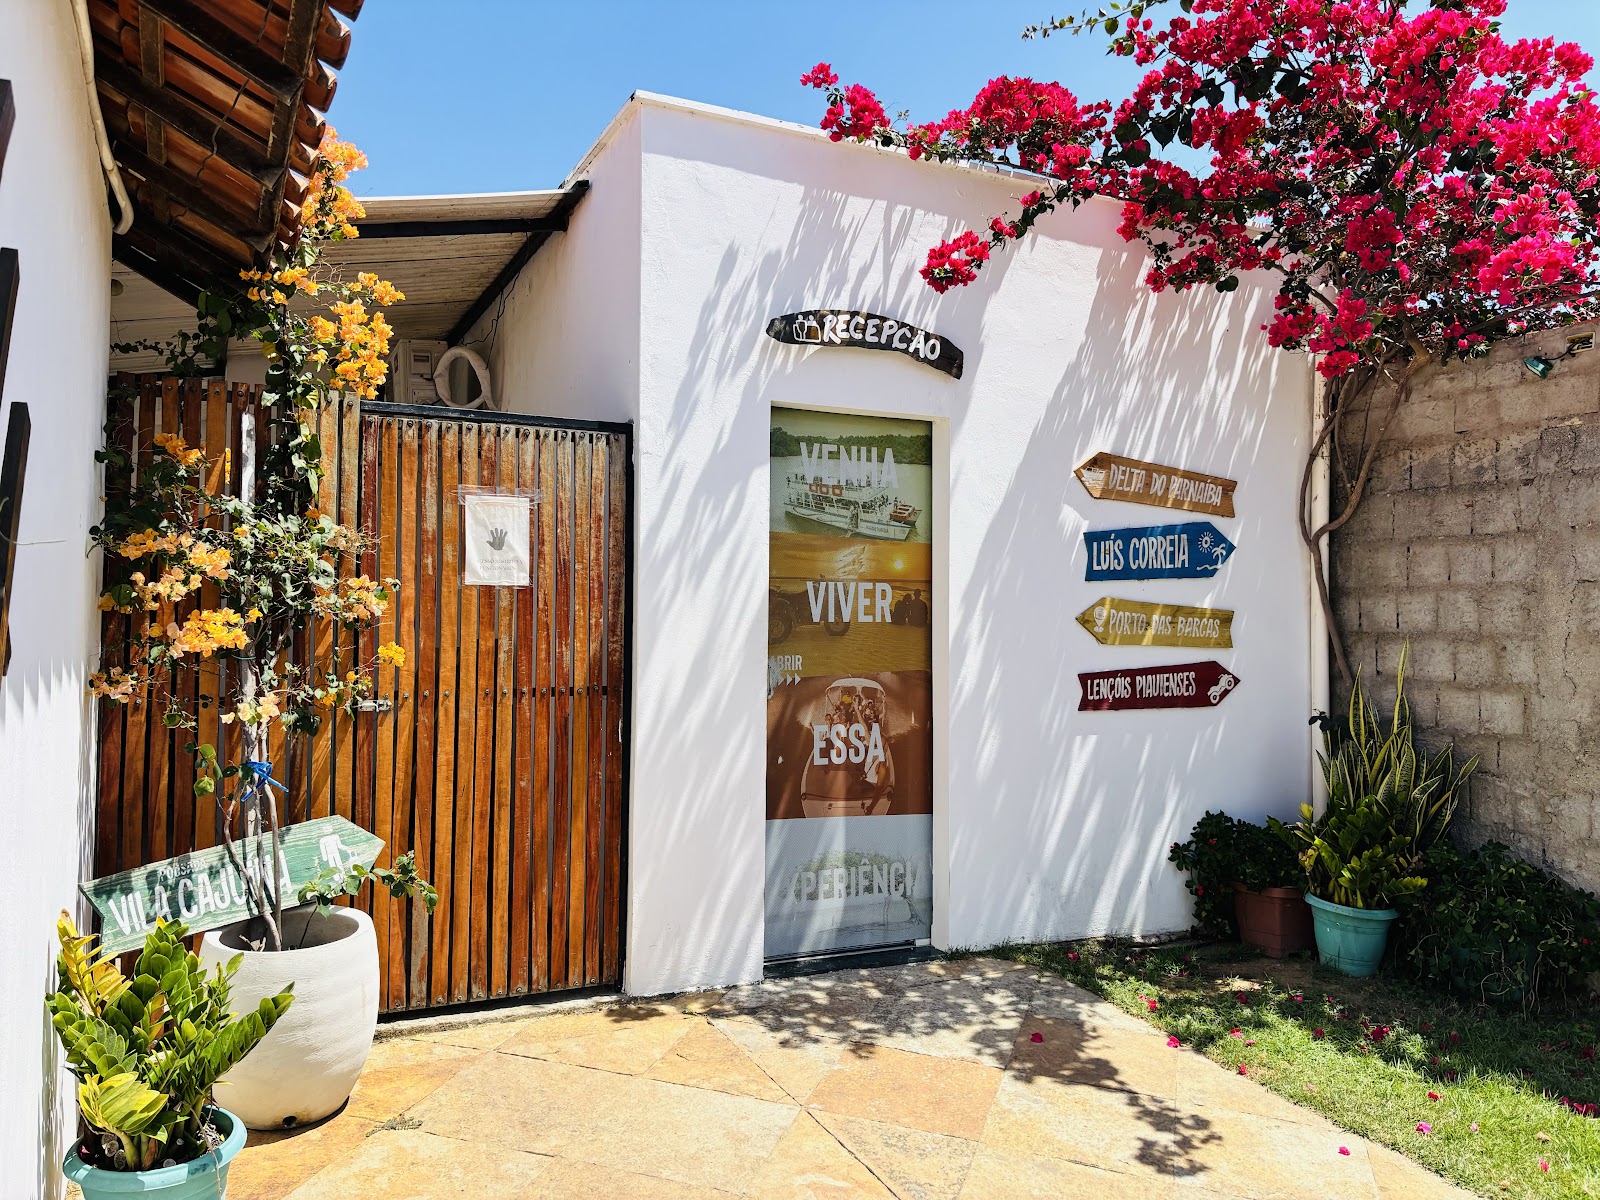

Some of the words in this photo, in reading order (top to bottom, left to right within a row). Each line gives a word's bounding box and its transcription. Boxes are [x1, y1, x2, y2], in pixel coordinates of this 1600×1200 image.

[800, 441, 899, 489] VENHA
[1108, 463, 1146, 494] DELTA
[1149, 472, 1167, 497] DO
[1168, 475, 1223, 507] PARNAÍBA
[1092, 533, 1125, 571] LUÍS
[1129, 533, 1189, 570] CORREIA
[806, 581, 893, 623] VIVER
[1109, 609, 1147, 635] PORTO
[1151, 614, 1172, 636] DAS
[1177, 616, 1221, 638] BARCAS
[1087, 673, 1131, 703] LENÇÓIS
[1136, 671, 1197, 699] PIAUIENSES
[813, 722, 886, 767] ESSA
[108, 885, 173, 936] VILA
